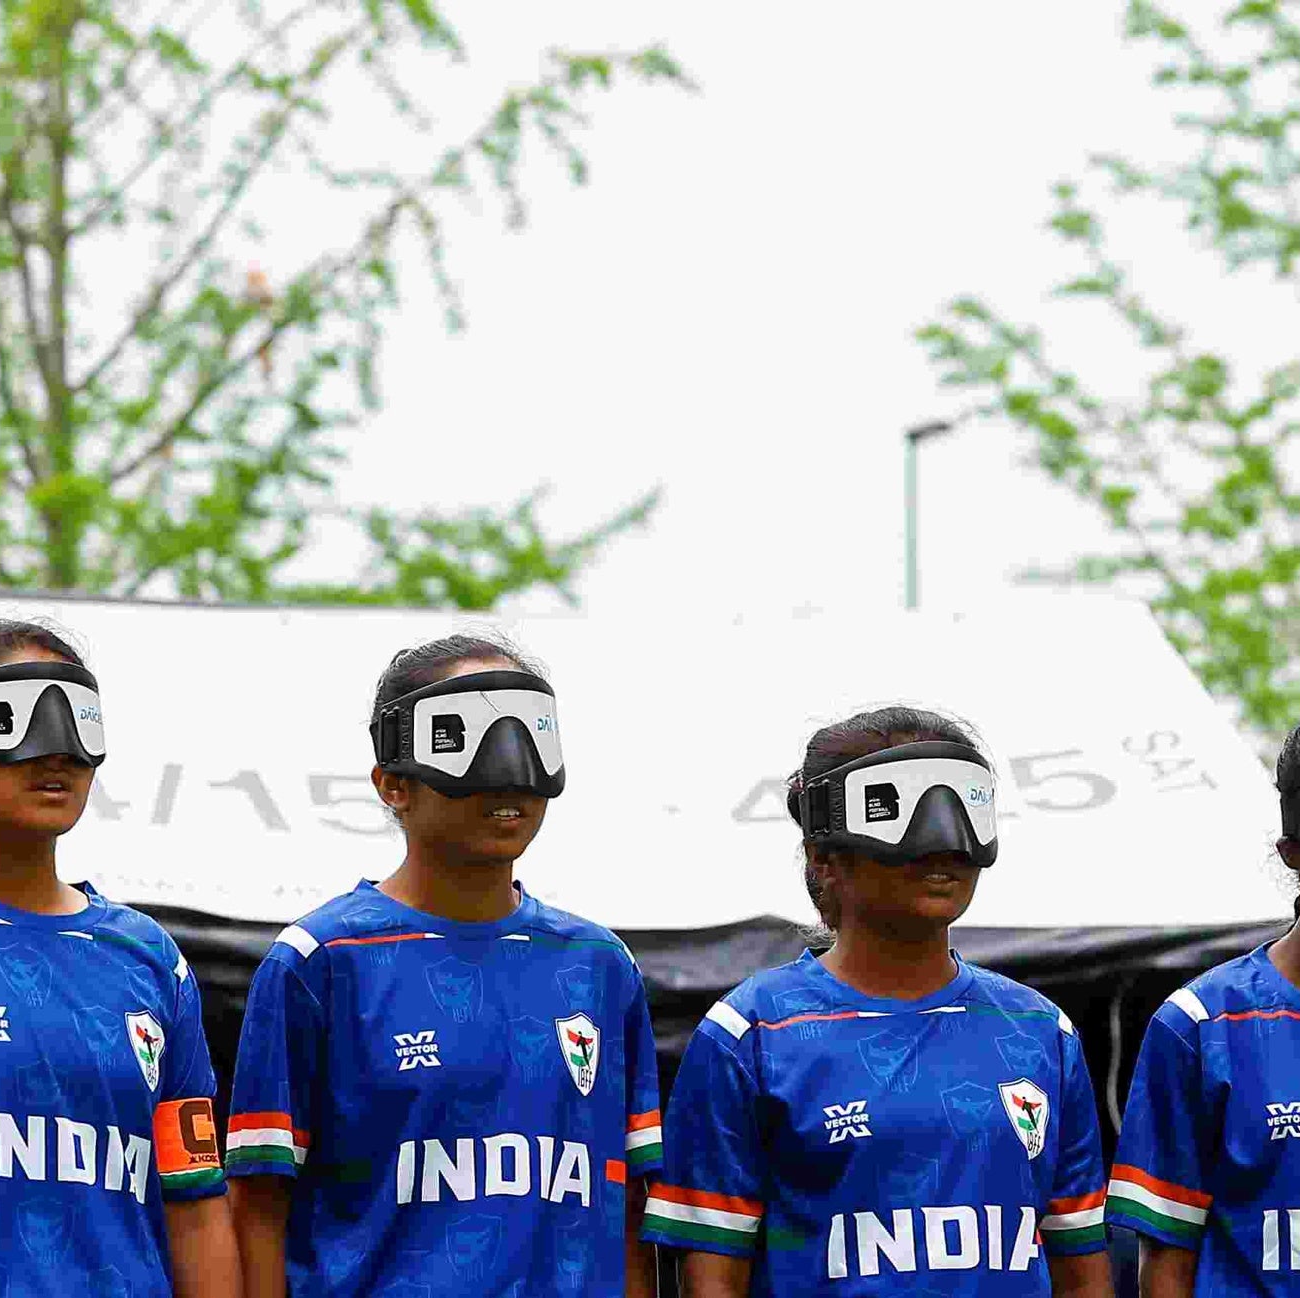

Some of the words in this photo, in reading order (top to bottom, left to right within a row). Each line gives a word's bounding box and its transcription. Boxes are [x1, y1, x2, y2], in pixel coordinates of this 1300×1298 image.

[395, 1044, 439, 1059] VECTOR
[178, 1100, 216, 1155] C
[824, 1113, 871, 1130] VECTOR
[396, 1132, 591, 1208] INDIA
[827, 1204, 1039, 1279] INDIA
